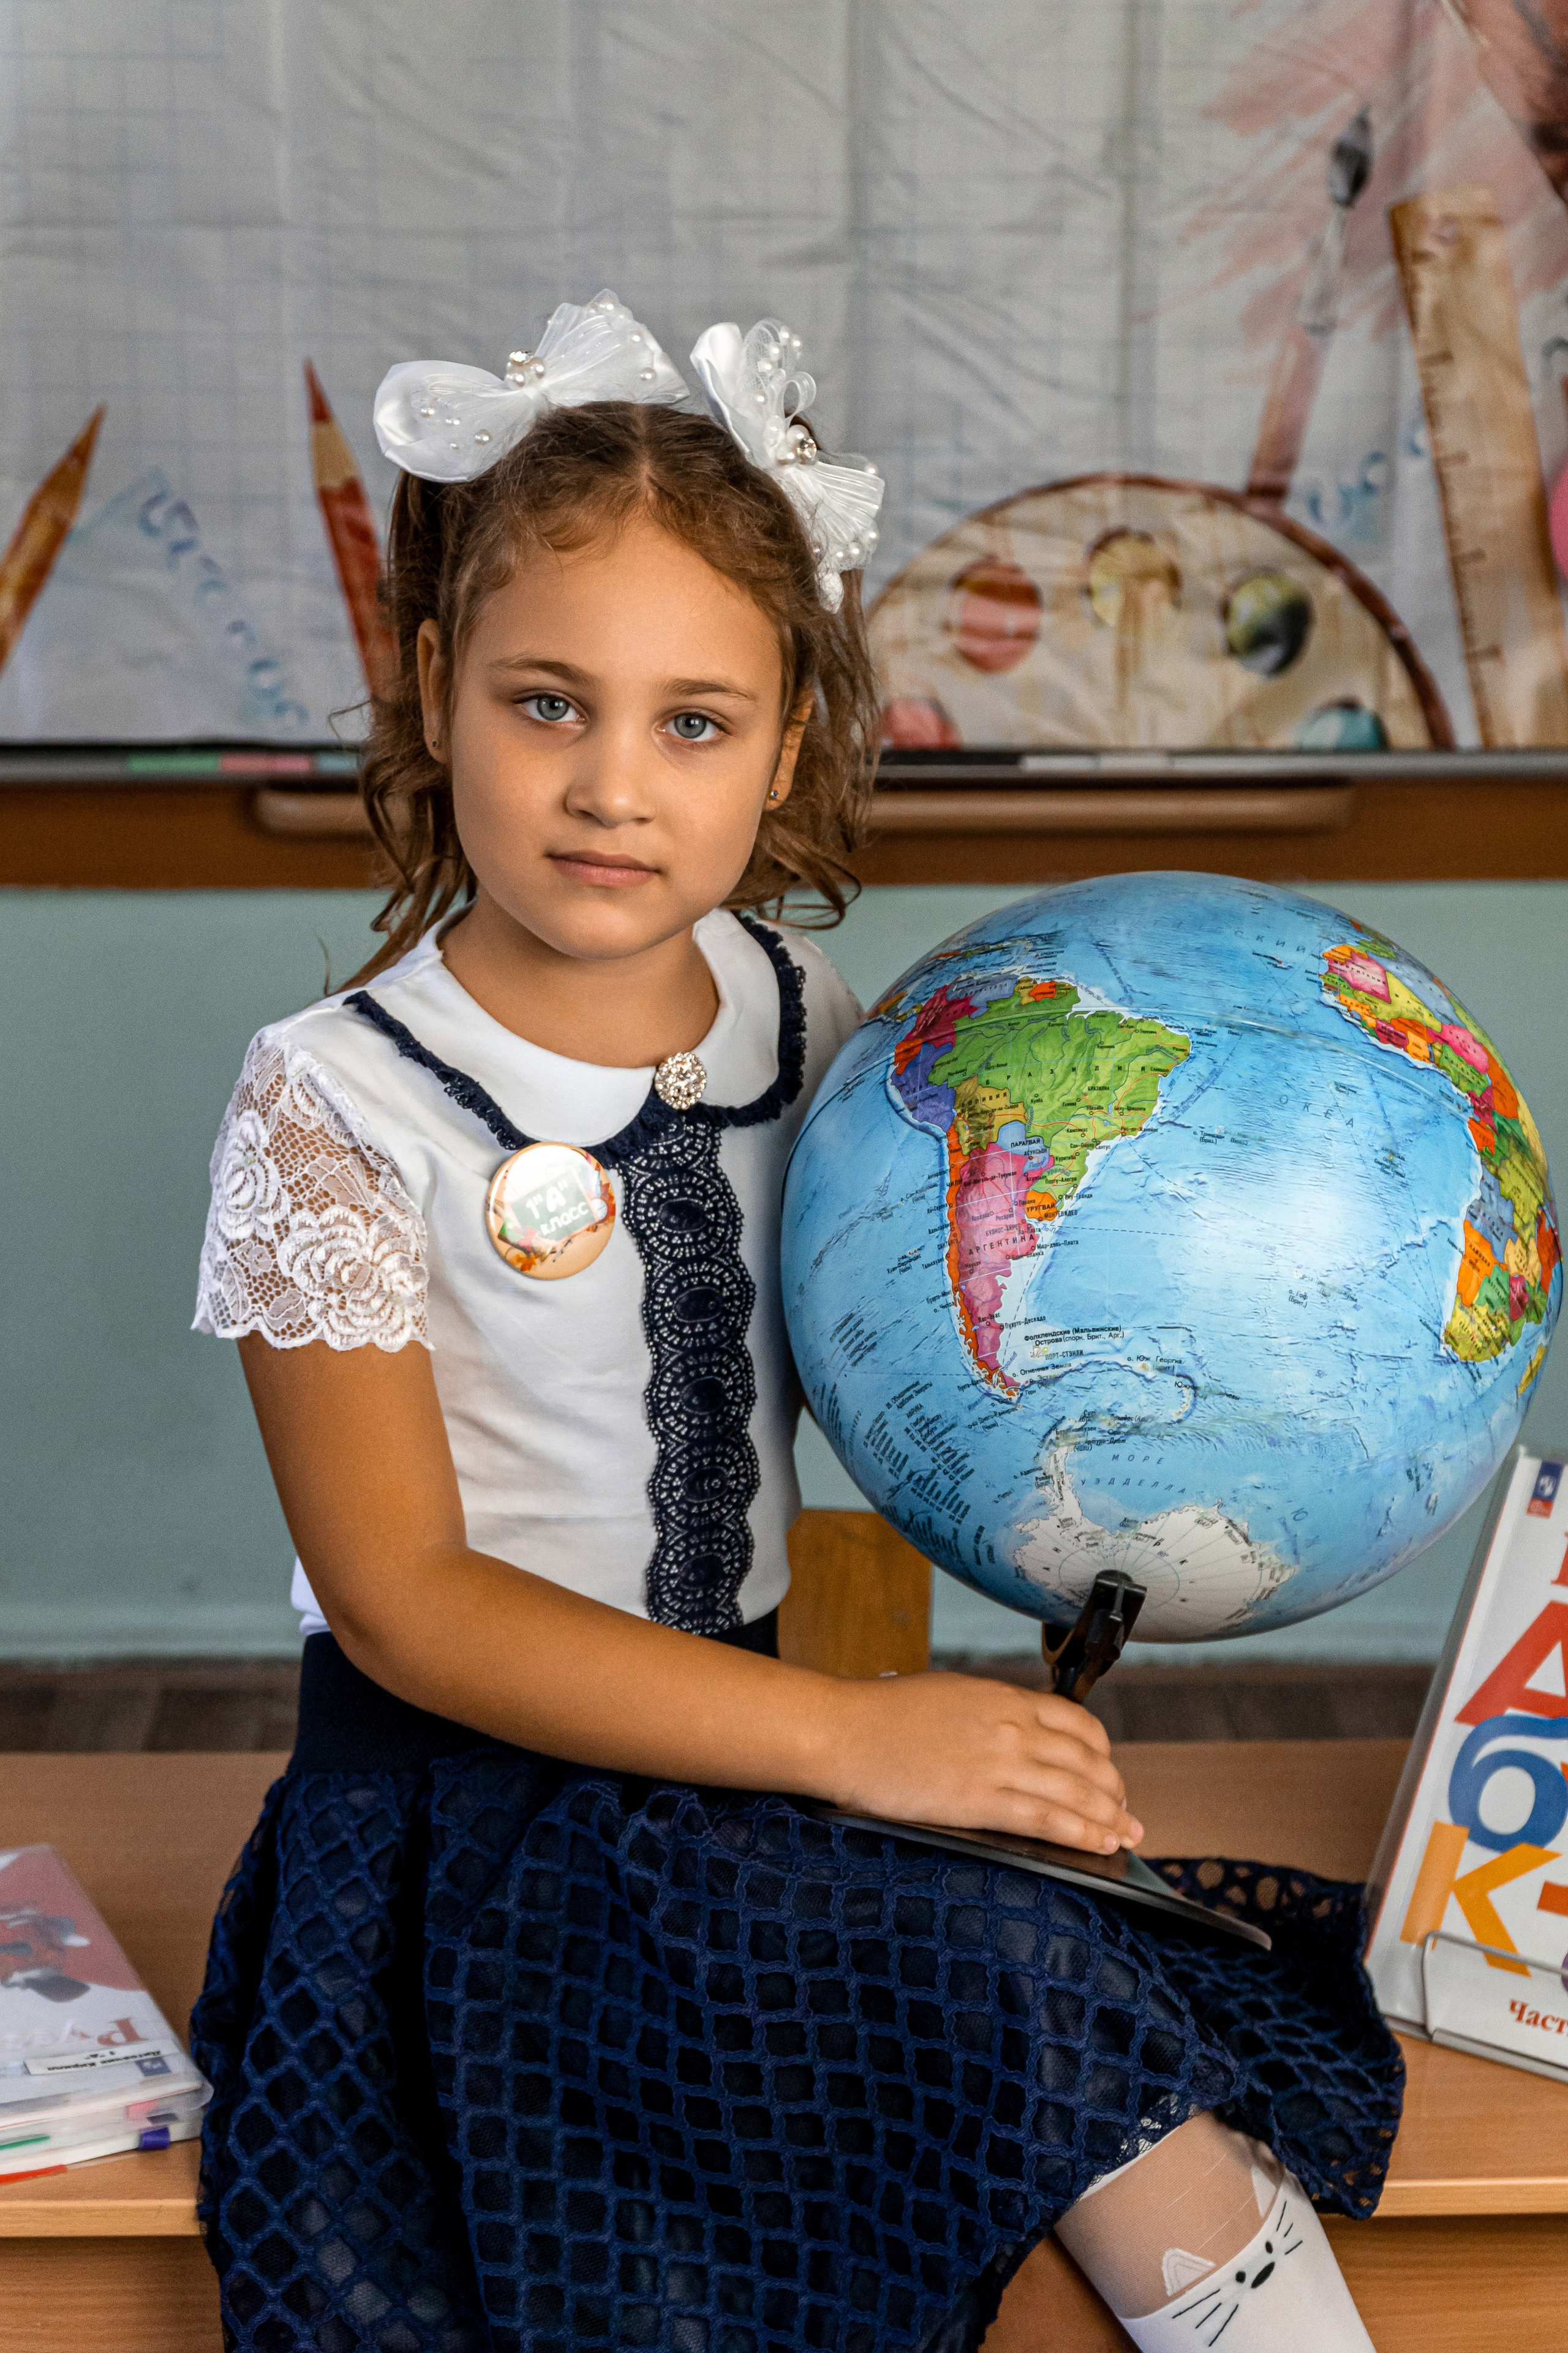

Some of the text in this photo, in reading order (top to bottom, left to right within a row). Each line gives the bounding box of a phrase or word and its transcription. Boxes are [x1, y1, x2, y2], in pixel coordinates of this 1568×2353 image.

[1011, 1138, 1041, 1148] ПАРАГВАЙ
[1045, 1176, 1077, 1185] Порту-Алегри
[1026, 1203, 1056, 1213] УРУГВАЙ
[1044, 1209, 1079, 1219] МОНТЕВИДЕО
[968, 1234, 1035, 1256] АРГЕНТИНА
[1036, 1239, 1079, 1250] Мар-дель-Плата
[1288, 1294, 1308, 1309] (Брит.)
[1005, 1315, 1046, 1329] Пуэрто-Десеадо
[1024, 1324, 1122, 1342] Фолклендские (Мальвинские)
[1035, 1337, 1063, 1346] Острова
[1045, 1349, 1084, 1361] ПОРТ-СТЭНЛИ
[1155, 1355, 1183, 1365] Георгия
[1020, 1366, 1050, 1377] Огненная
[1050, 1362, 1072, 1370] Земля
[906, 1403, 924, 1419] АФРИКА
[1112, 1454, 1164, 1465] МОРЕ
[1080, 1477, 1186, 1494] УЭДДЕЛЛА
[1508, 1998, 1568, 2036] Част
